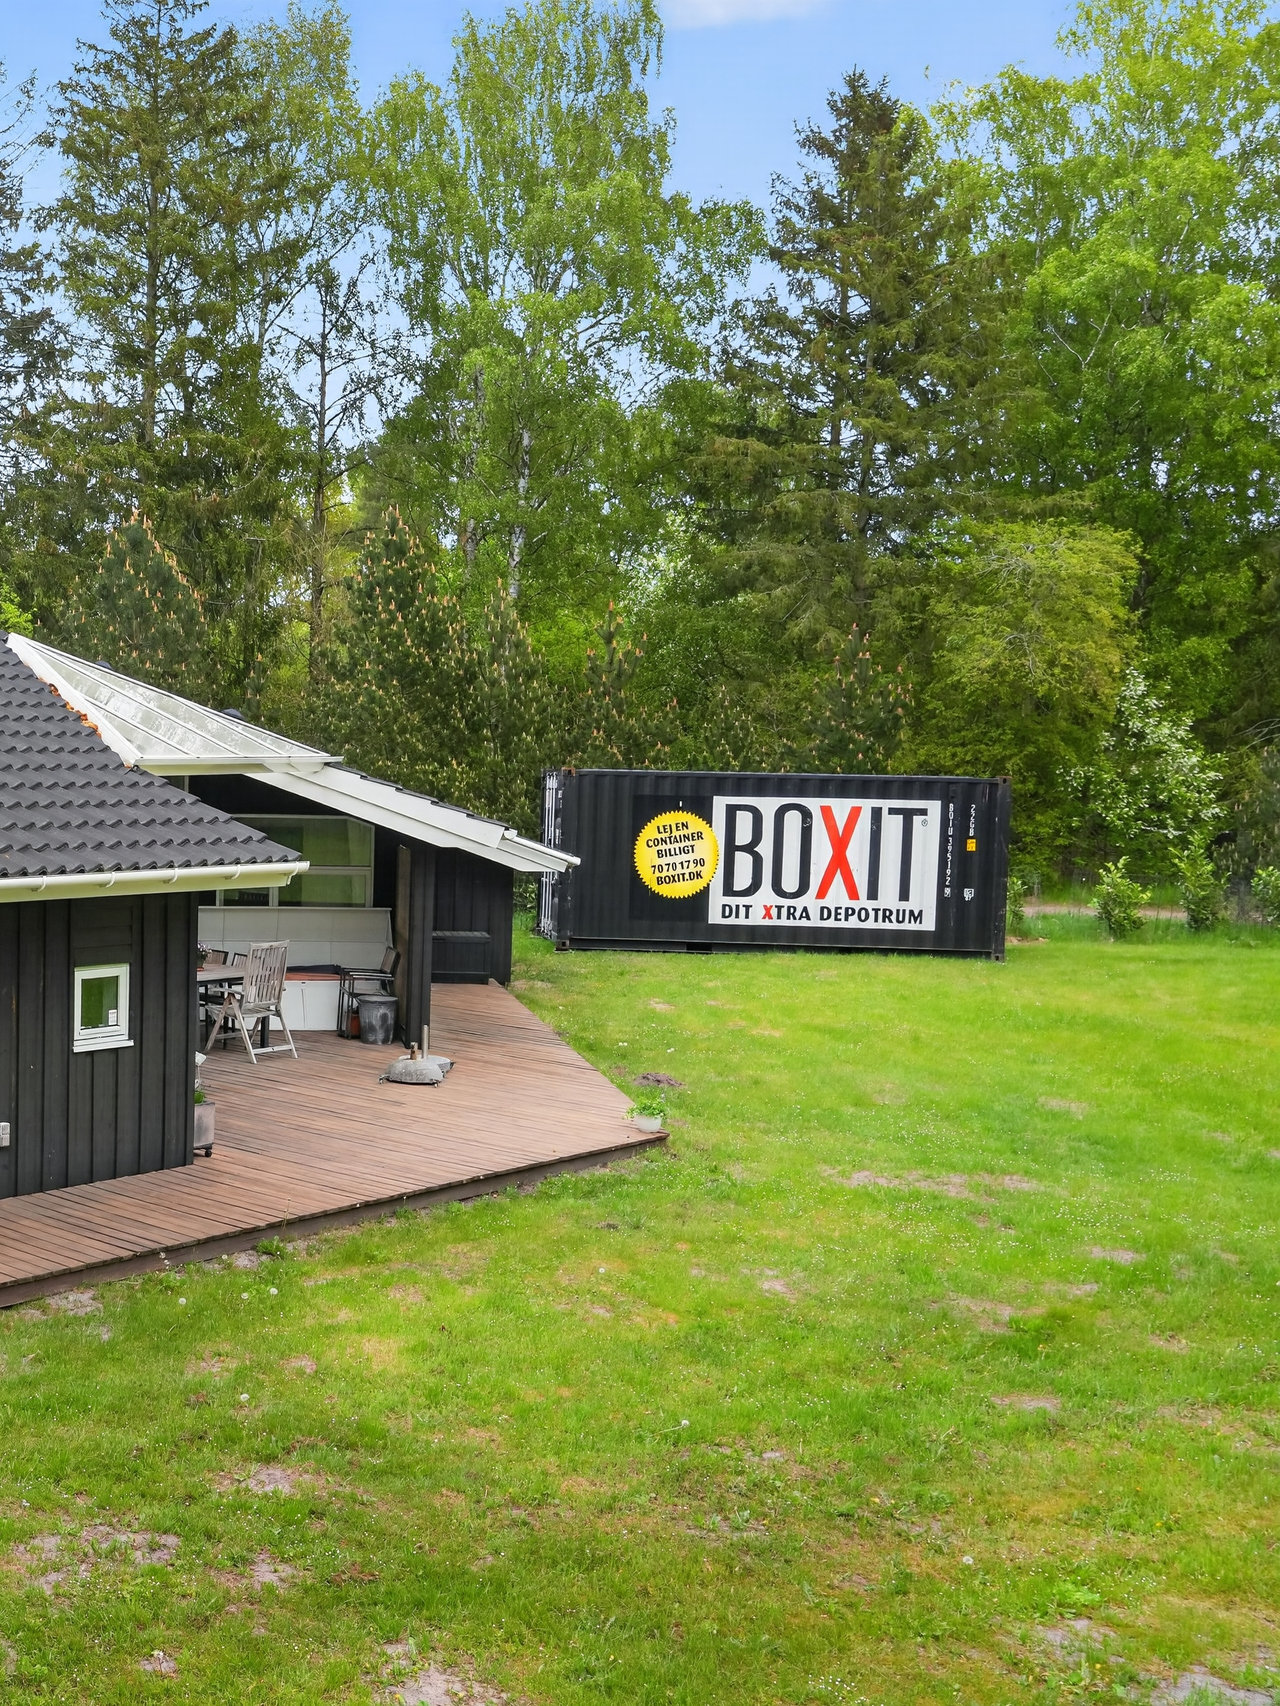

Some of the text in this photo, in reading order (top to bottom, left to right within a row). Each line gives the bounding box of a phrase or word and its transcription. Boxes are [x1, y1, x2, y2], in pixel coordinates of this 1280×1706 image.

[656, 821, 689, 836] LEJ EN
[646, 831, 704, 848] CONTAINER
[656, 844, 695, 859] BILLIGT
[722, 802, 928, 902] BOXIT
[651, 857, 706, 875] 70 70 17 90
[656, 870, 703, 886] BOXIT.DK
[721, 904, 924, 925] DIT XTRA DEPOTRUM
